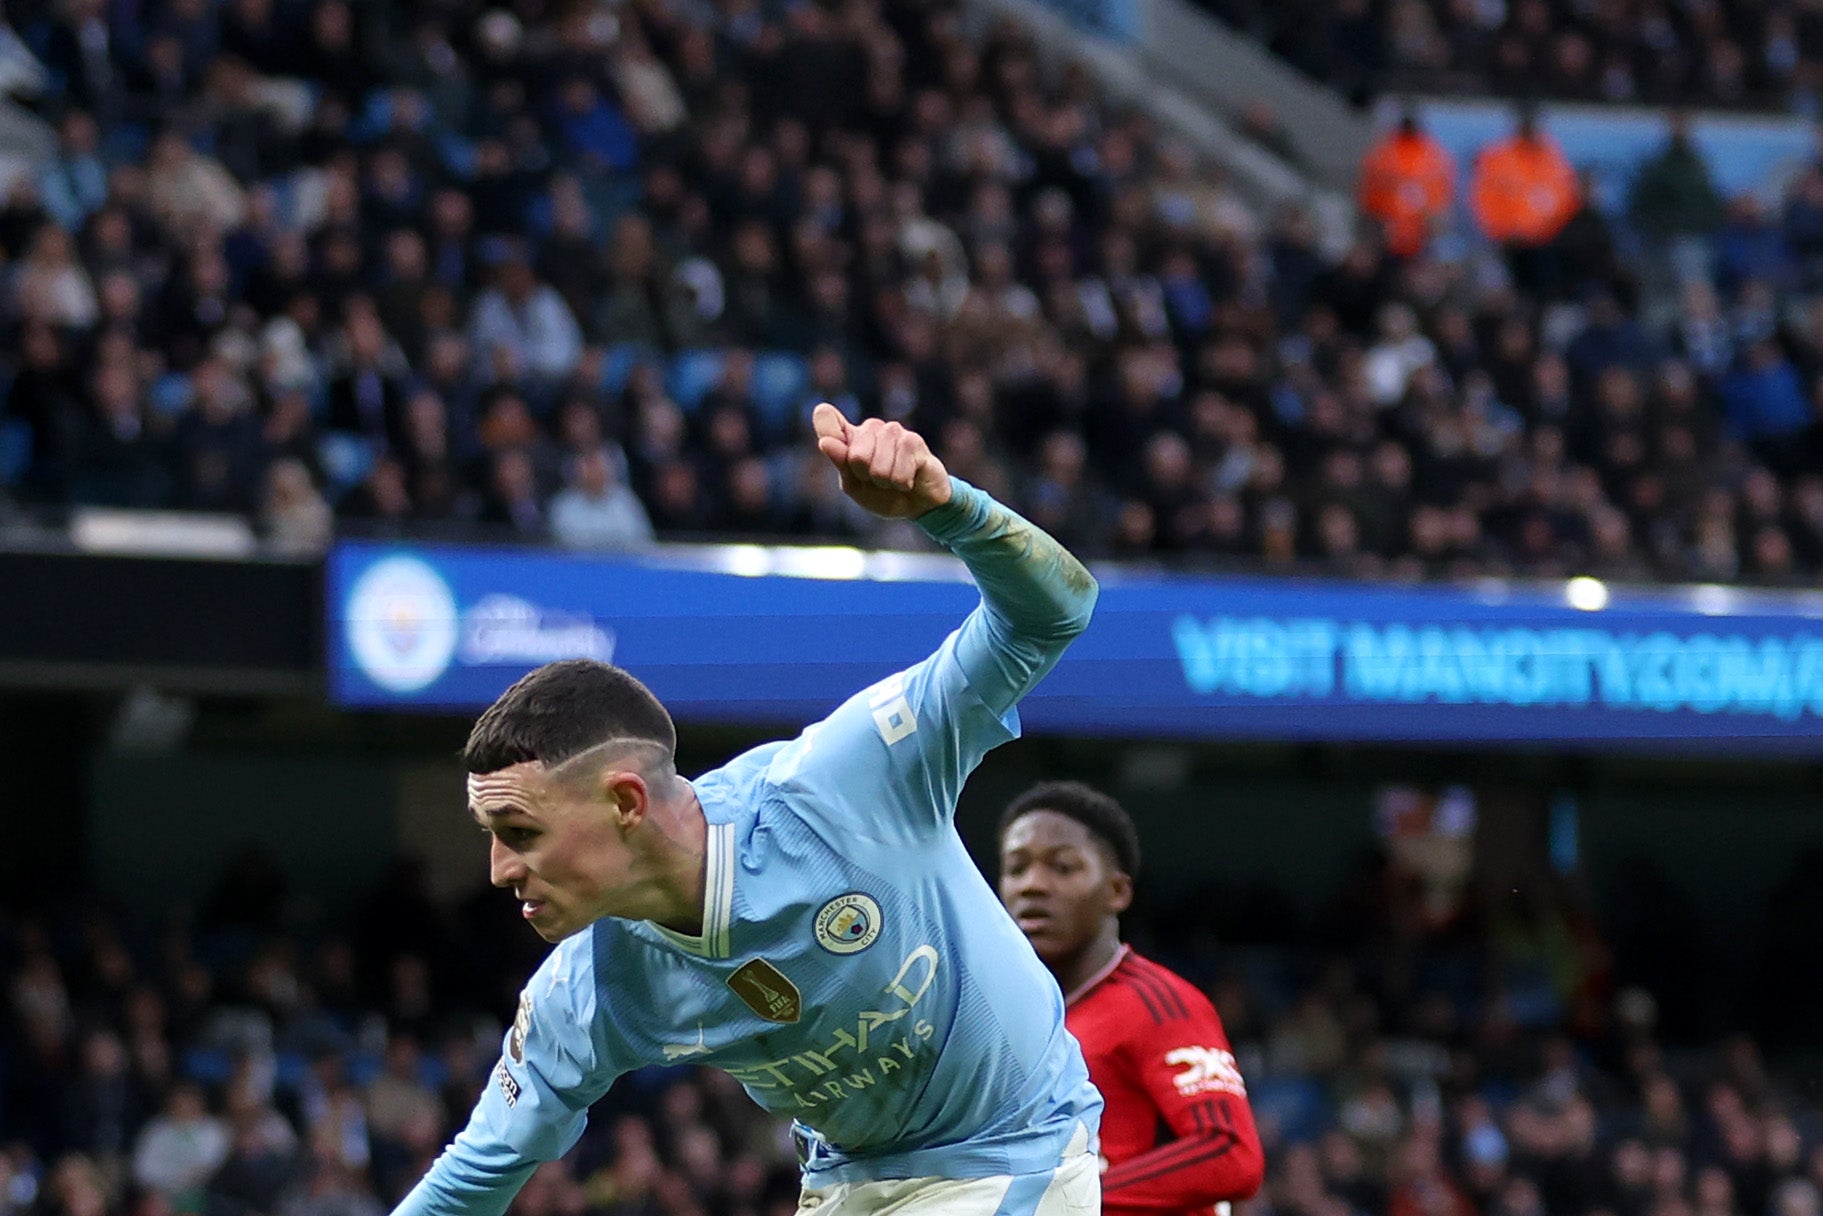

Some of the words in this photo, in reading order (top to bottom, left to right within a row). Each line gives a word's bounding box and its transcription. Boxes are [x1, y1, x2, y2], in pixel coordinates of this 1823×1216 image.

[1172, 614, 1335, 697] VISIT
[860, 927, 877, 946] CITY
[769, 995, 791, 1013] FIFA
[792, 1018, 935, 1108] AIRWAYS
